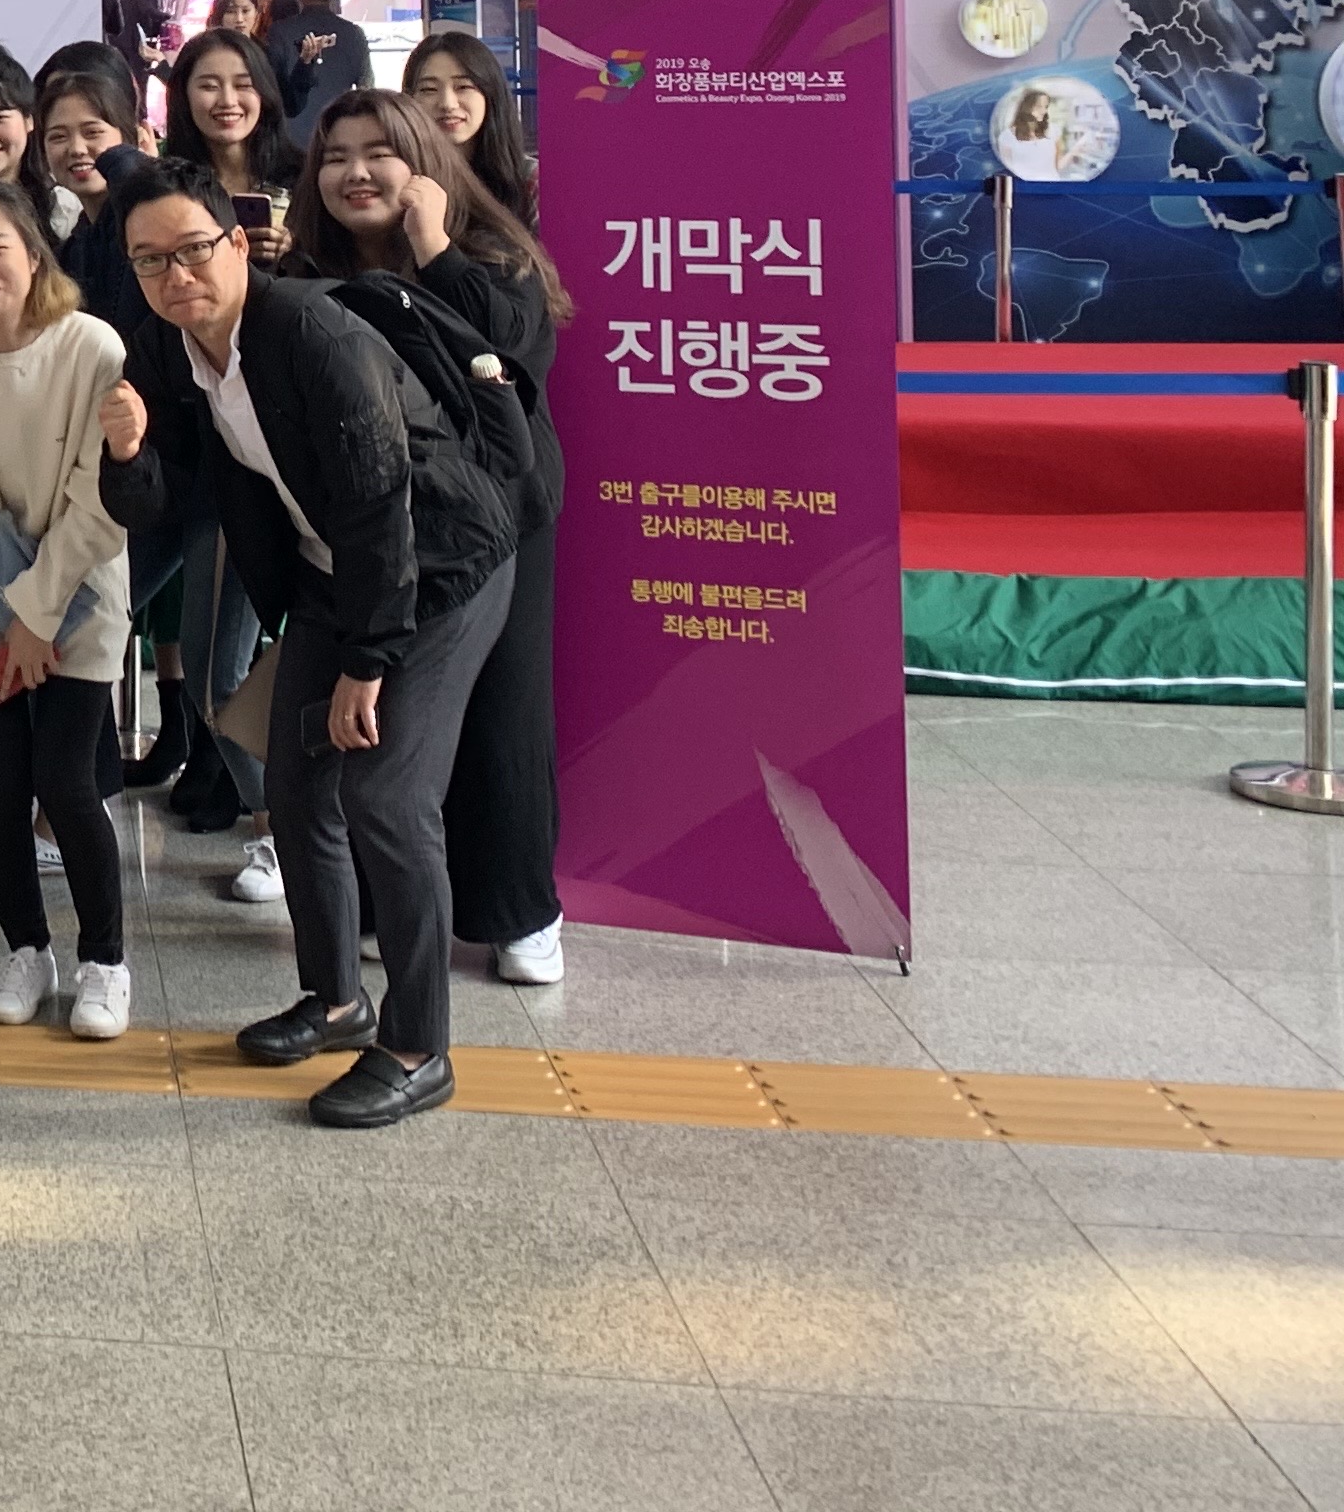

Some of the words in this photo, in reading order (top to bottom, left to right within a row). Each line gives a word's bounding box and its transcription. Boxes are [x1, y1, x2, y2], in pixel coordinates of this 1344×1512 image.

[655, 58, 685, 69] 2019
[688, 58, 712, 70] 오송
[655, 70, 847, 92] 화장품뷰티산업엑스포
[655, 94, 699, 103] Cosmetics
[708, 94, 739, 104] Beauty
[765, 94, 795, 103] Osong
[796, 93, 823, 102] Korea
[824, 93, 847, 102] 2019
[602, 215, 825, 297] 개막식
[603, 318, 831, 403] 진행중
[599, 481, 634, 504] 3번
[771, 489, 837, 515] 주시면
[641, 514, 795, 546] 감사하겠습니다.
[630, 578, 694, 606] 통행에
[699, 583, 806, 614] 불편을드려
[663, 614, 775, 644] 죄송합니다.
